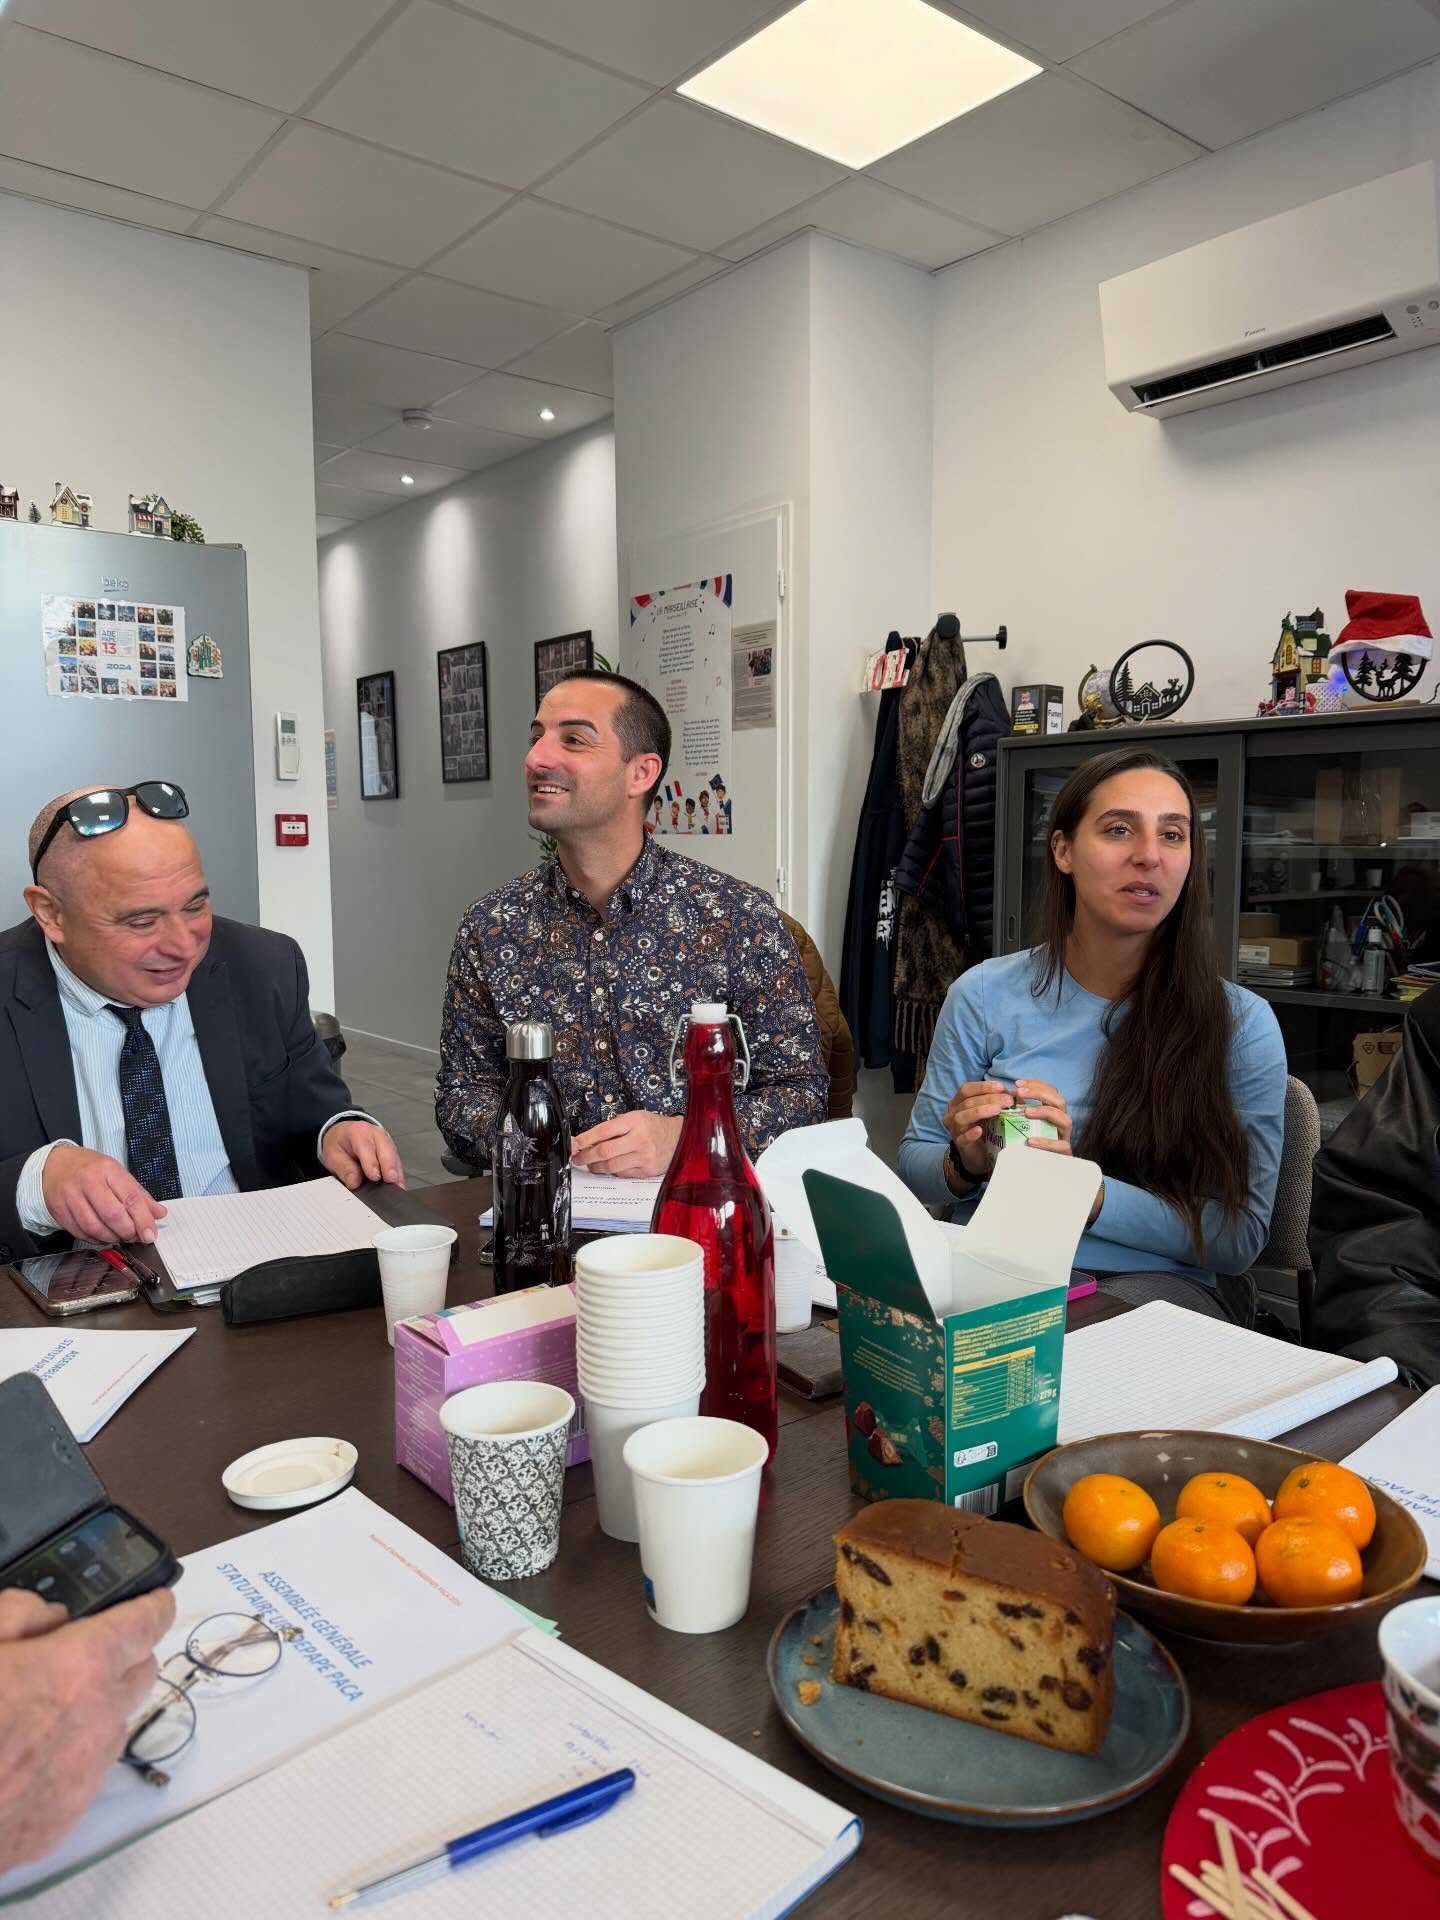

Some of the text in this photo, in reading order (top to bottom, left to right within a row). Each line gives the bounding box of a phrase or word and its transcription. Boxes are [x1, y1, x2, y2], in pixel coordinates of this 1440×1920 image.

[101, 641, 117, 655] 13
[105, 663, 132, 671] 2024
[216, 1562, 279, 1618] STATUTAIRE
[292, 1632, 337, 1673] DEPAPE
[325, 1670, 365, 1702] PACA
[257, 1569, 321, 1622] ASSEMBLÉE
[311, 1617, 373, 1670] GÉNÉRALE
